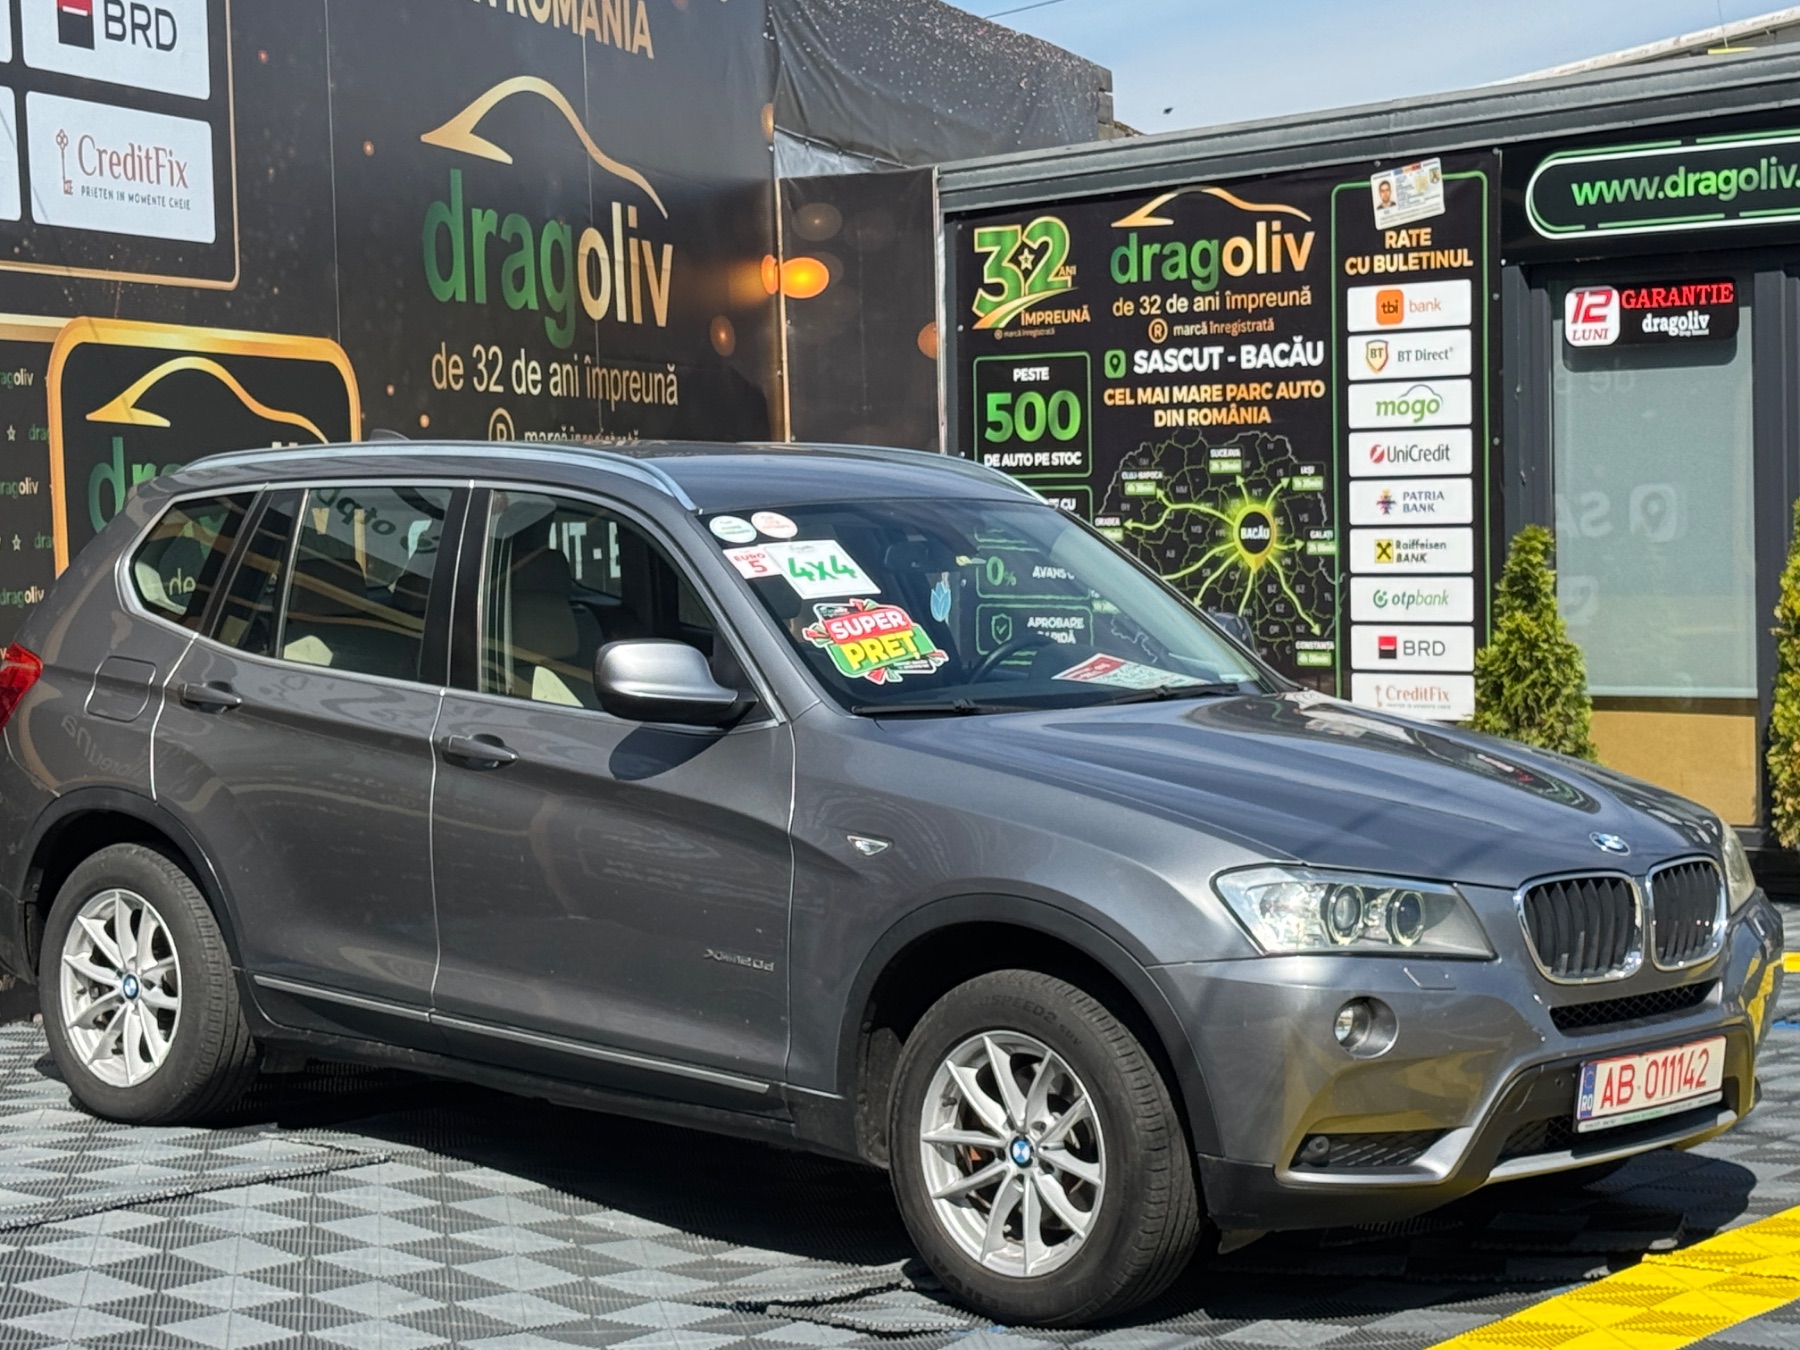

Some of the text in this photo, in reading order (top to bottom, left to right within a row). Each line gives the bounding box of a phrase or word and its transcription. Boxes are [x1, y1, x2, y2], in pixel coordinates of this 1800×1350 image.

[103, 0, 178, 52] BRD
[78, 134, 189, 189] CreditFix
[81, 185, 191, 211] PRIETEN IN MOMENTE CHEIE
[1384, 227, 1432, 249] RATE
[422, 168, 673, 349] dragoliv
[972, 216, 1071, 318] 32
[1110, 220, 1316, 292] dragoliv
[1344, 248, 1474, 276] CU BULETINUL
[1112, 285, 1312, 317] de 32 de ani împreună
[1381, 298, 1442, 314] tbi bank
[1571, 289, 1613, 324] 12
[1621, 282, 1735, 310] GARANTIE
[1021, 304, 1091, 326] ÎMPREUNĂ
[1641, 310, 1710, 337] dragoliv
[1173, 322, 1208, 336] marcă
[1209, 317, 1275, 337] înregistrată
[1571, 328, 1609, 342] LUNI
[1133, 346, 1225, 374] SASCUT
[1240, 335, 1325, 370] BACĂU
[1370, 347, 1384, 359] BT
[1397, 349, 1413, 362] BT
[431, 341, 679, 412] de 32 de ani împreună
[1013, 367, 1050, 382] PESTE
[1103, 380, 1326, 406] CEL MAI MARE PARC AUTO
[984, 389, 1082, 443] 500
[1154, 403, 1272, 428] DIN ROMÂNIA
[1375, 397, 1441, 423] mogo
[28, 424, 50, 443] dra
[984, 451, 1082, 467] DE AUTO PE STOC
[1387, 443, 1451, 463] UniCredit
[1060, 498, 1076, 511] CU
[1402, 490, 1445, 502] PATRIA
[1402, 503, 1436, 513] BANK
[1240, 525, 1270, 540] BACĂU
[1395, 539, 1447, 551] Raiffeisen
[750, 560, 768, 573] 5
[1396, 553, 1428, 564] BANK
[1391, 589, 1449, 610] otpbank
[830, 610, 908, 640] SUPER
[1027, 616, 1085, 630] APROBARE
[1402, 640, 1446, 657] BRD
[1385, 684, 1450, 702] CreditFix
[1600, 1047, 1710, 1109] AB 011142
